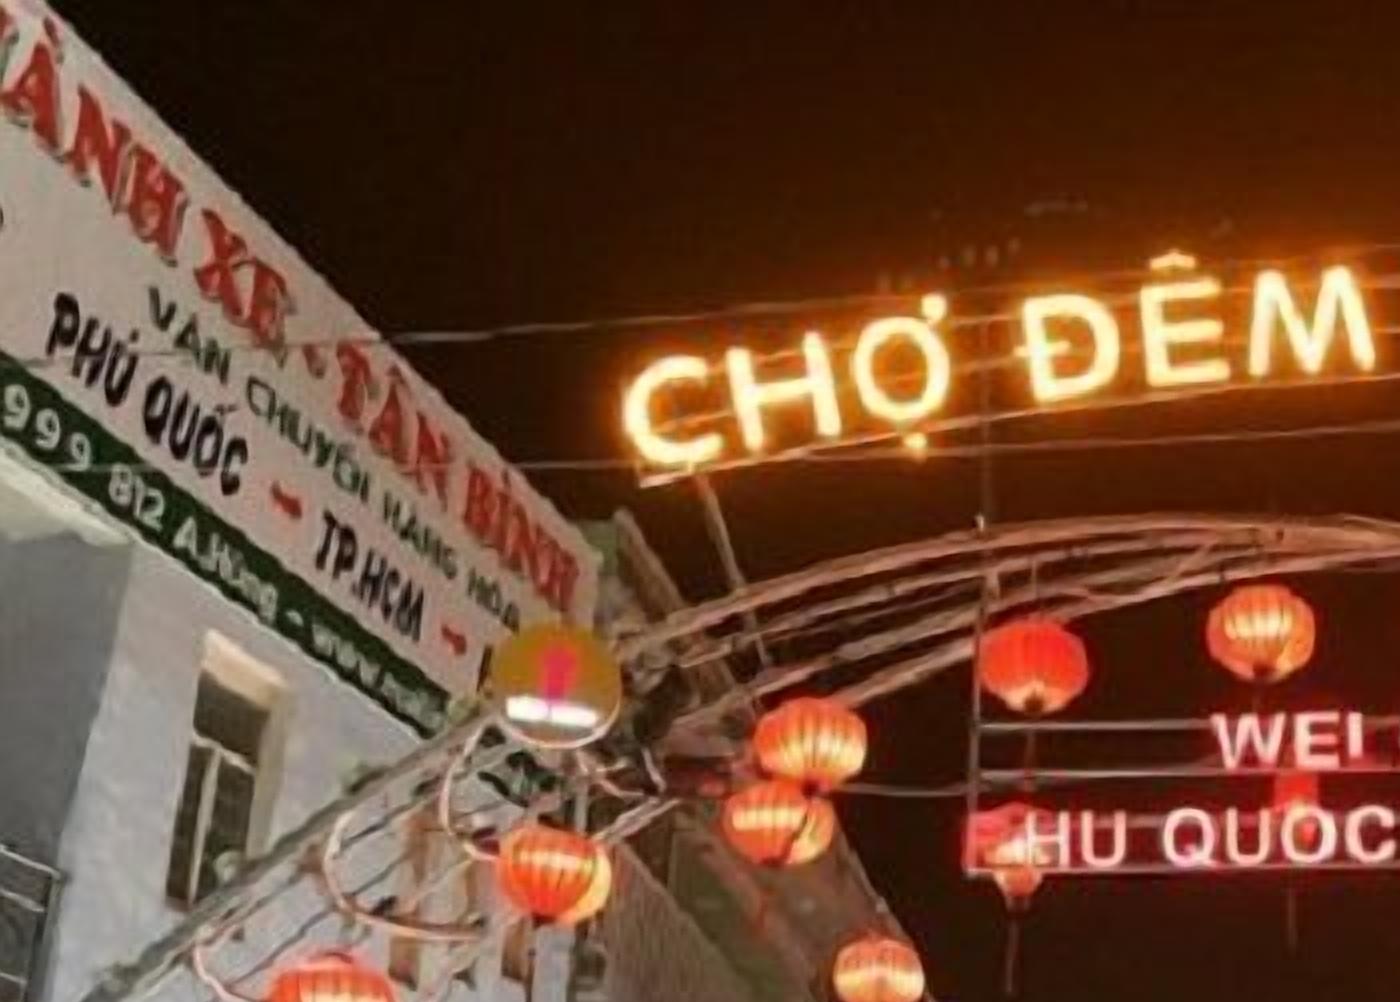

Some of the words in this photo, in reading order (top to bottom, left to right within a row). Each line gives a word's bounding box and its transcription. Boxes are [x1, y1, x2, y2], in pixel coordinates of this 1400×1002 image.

[622, 291, 951, 466] CHỢ
[1014, 250, 1377, 402] ĐÊM
[46, 291, 138, 407] PHÚ
[142, 374, 249, 496] QUỐC
[314, 508, 425, 643] TP.HCM
[967, 811, 1127, 868] HU
[1162, 805, 1397, 868] QUOC
